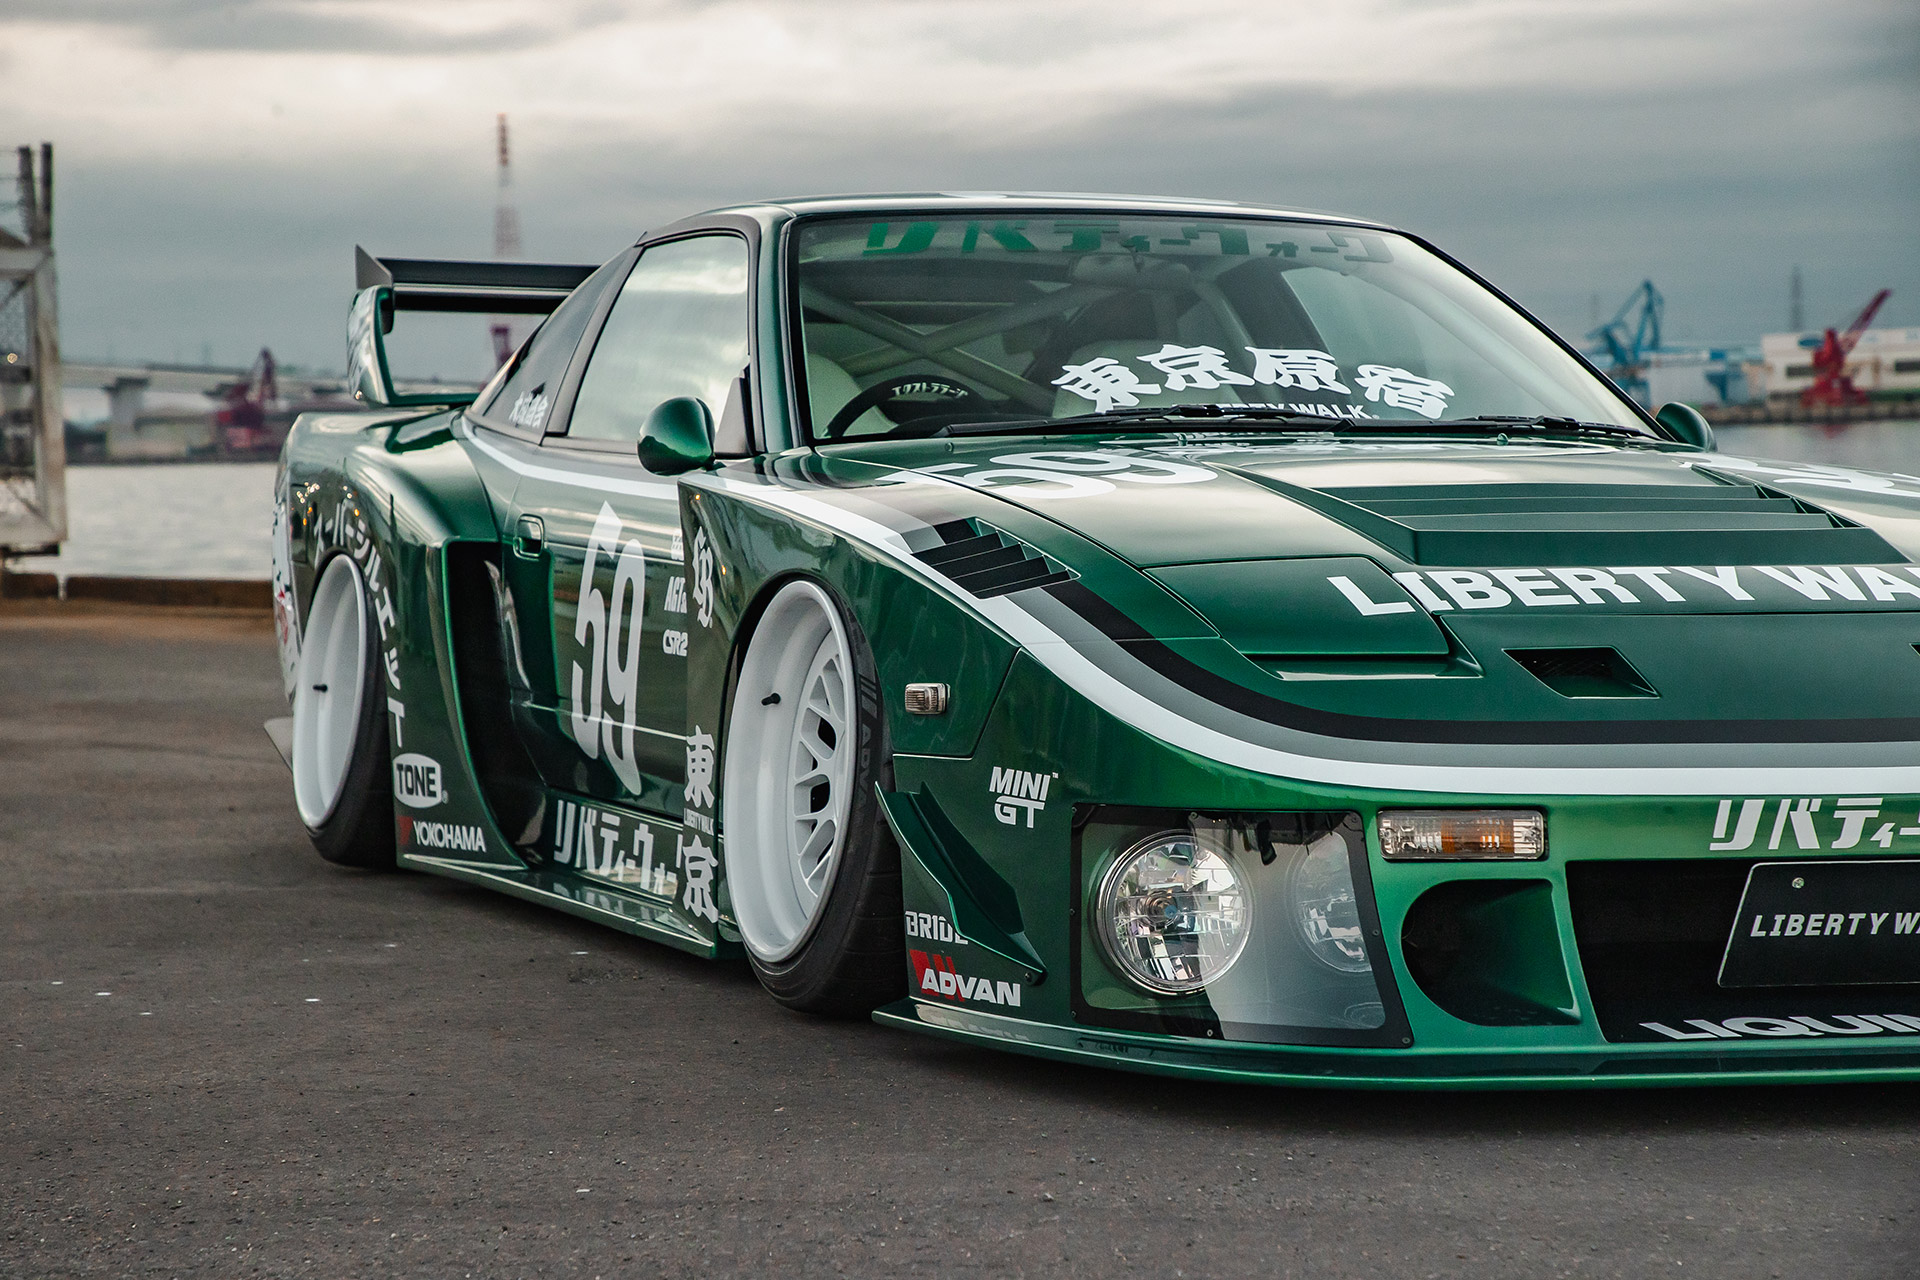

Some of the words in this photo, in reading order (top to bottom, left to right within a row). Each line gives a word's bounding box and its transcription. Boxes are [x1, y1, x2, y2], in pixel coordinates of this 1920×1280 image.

[1051, 344, 1455, 419] 東京原宿
[875, 451, 1219, 499] 59
[1327, 566, 1755, 616] LIBERTY
[1748, 566, 1920, 601] WA
[571, 500, 646, 796] 59
[396, 763, 437, 798] TONE
[989, 766, 1051, 801] MINI
[994, 795, 1045, 829] GT
[1709, 797, 1920, 850] リバティー
[413, 820, 487, 853] YOKOHAMA
[1750, 912, 1890, 938] LIBERTY
[1894, 912, 1920, 935] W
[921, 967, 1021, 1007] ADVAN
